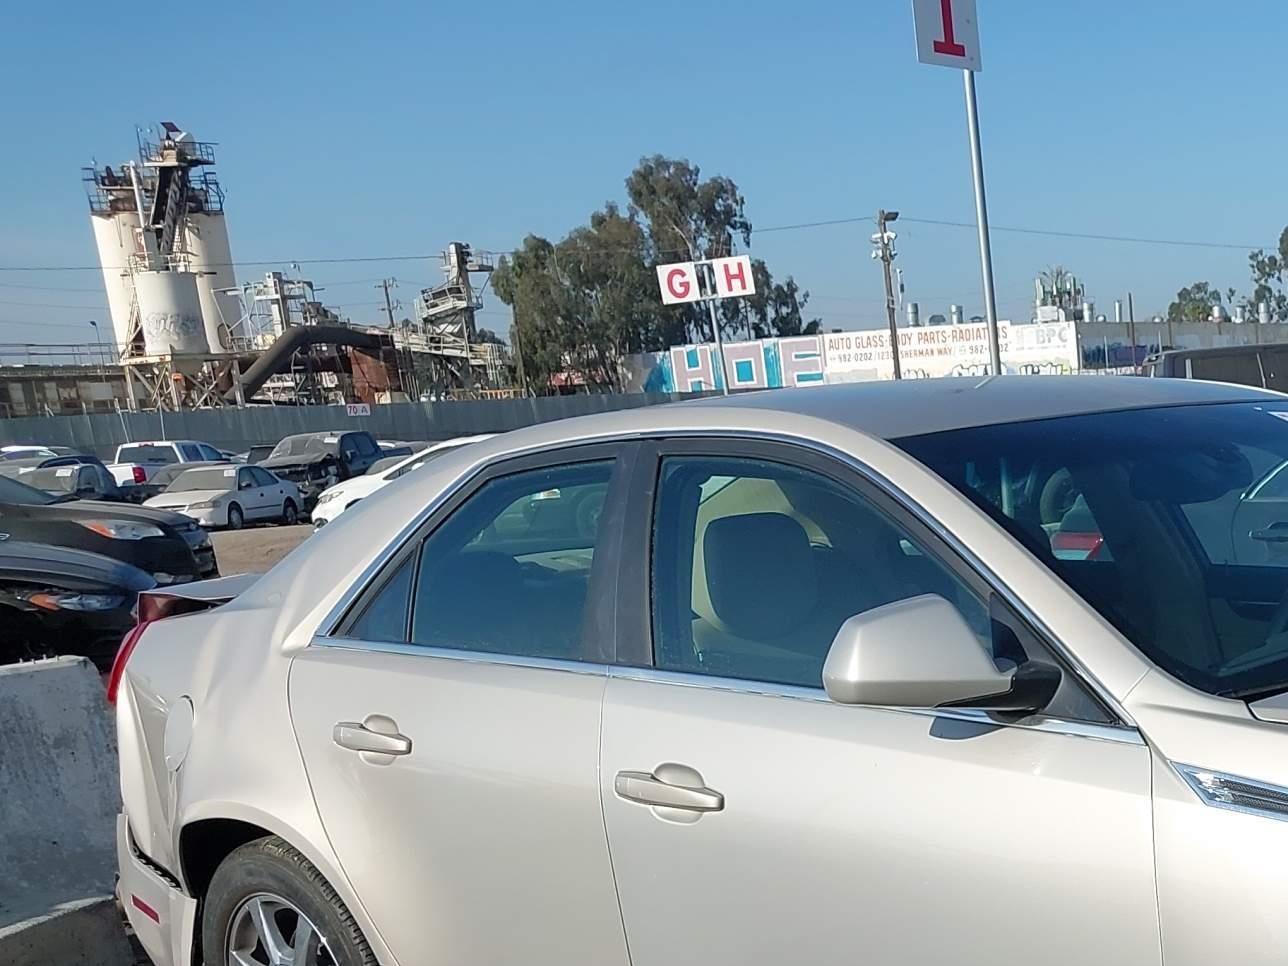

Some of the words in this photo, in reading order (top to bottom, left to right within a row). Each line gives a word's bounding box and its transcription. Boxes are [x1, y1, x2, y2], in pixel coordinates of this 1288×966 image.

[667, 268, 690, 299] G
[723, 262, 747, 292] H
[828, 336, 852, 351] AUTO
[937, 346, 953, 356] WAY
